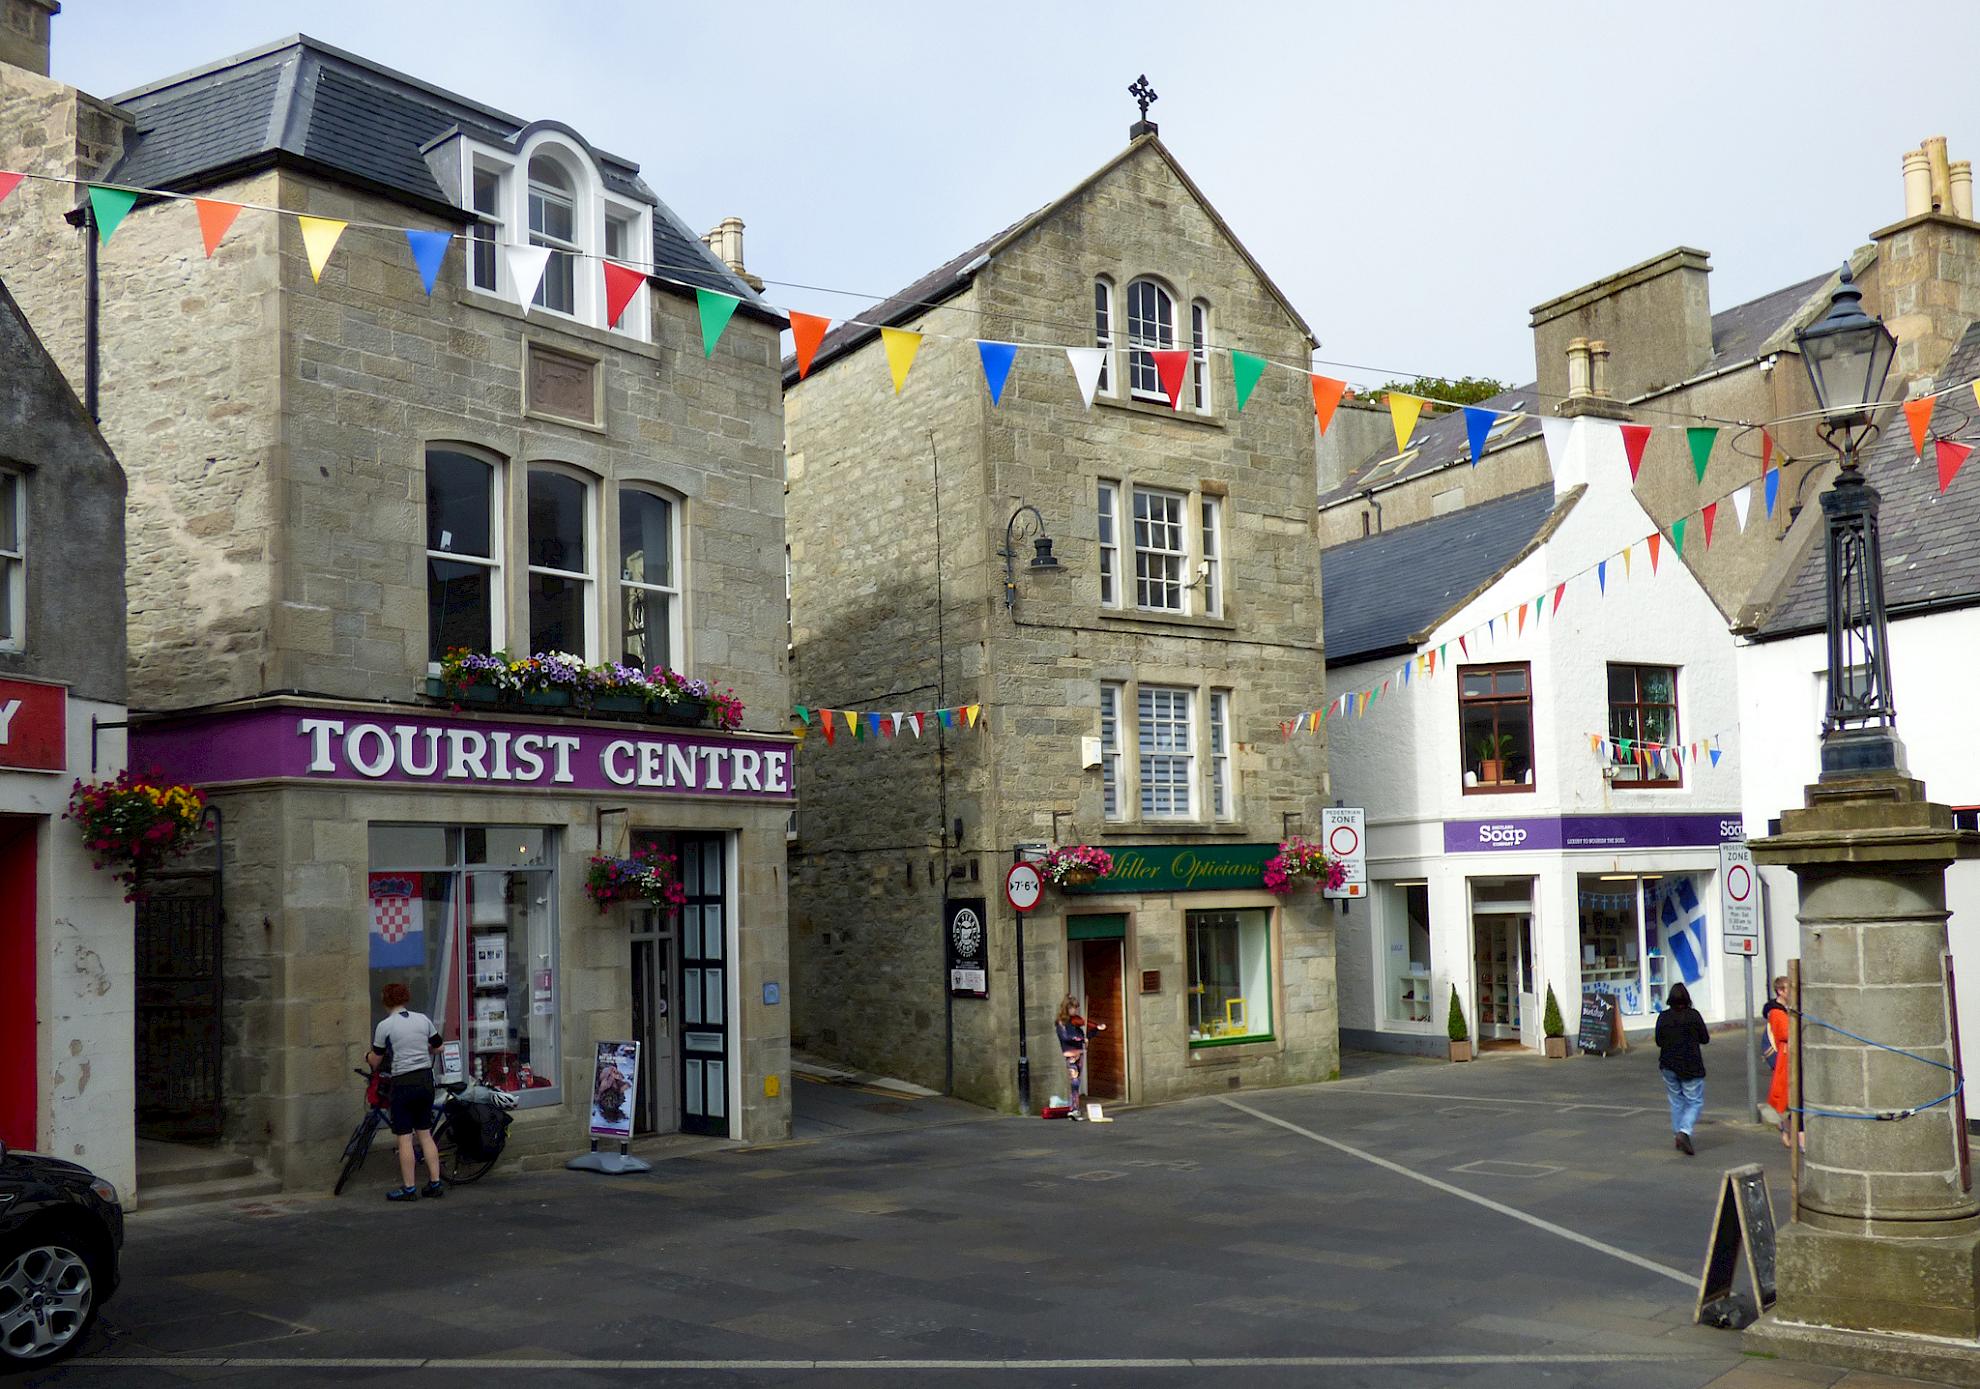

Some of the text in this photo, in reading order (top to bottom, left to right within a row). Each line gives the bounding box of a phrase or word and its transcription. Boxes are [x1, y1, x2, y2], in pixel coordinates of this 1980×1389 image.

[298, 718, 787, 793] TOURIST CENTRE
[1479, 825, 1527, 845] Soap
[1172, 851, 1260, 887] Opticians
[1728, 851, 1748, 861] ZONE
